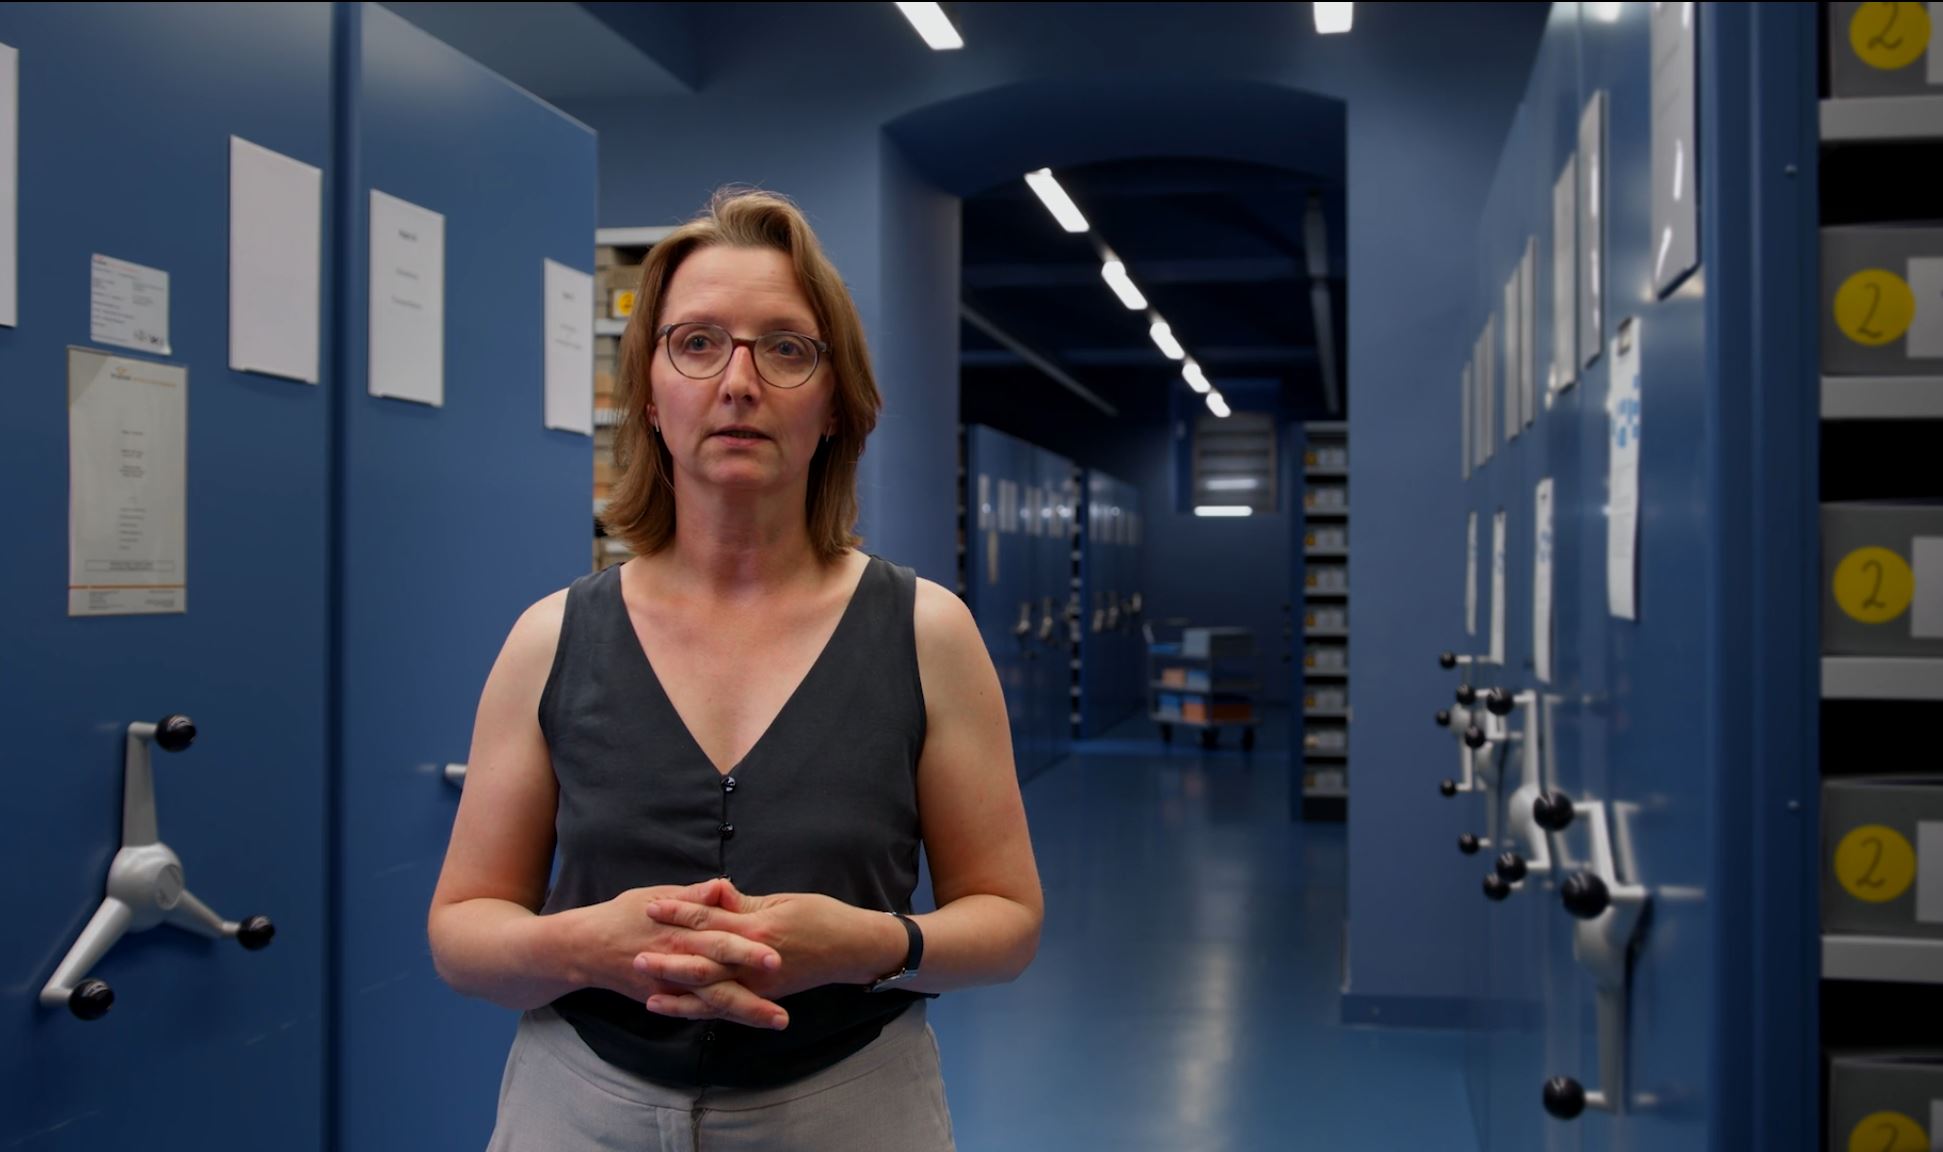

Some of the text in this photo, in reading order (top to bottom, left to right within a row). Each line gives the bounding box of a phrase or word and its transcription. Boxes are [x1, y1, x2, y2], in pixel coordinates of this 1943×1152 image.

[1867, 2, 1904, 50] 2
[1857, 281, 1884, 339] 2
[1861, 558, 1887, 612] 2
[1856, 836, 1887, 889] 2
